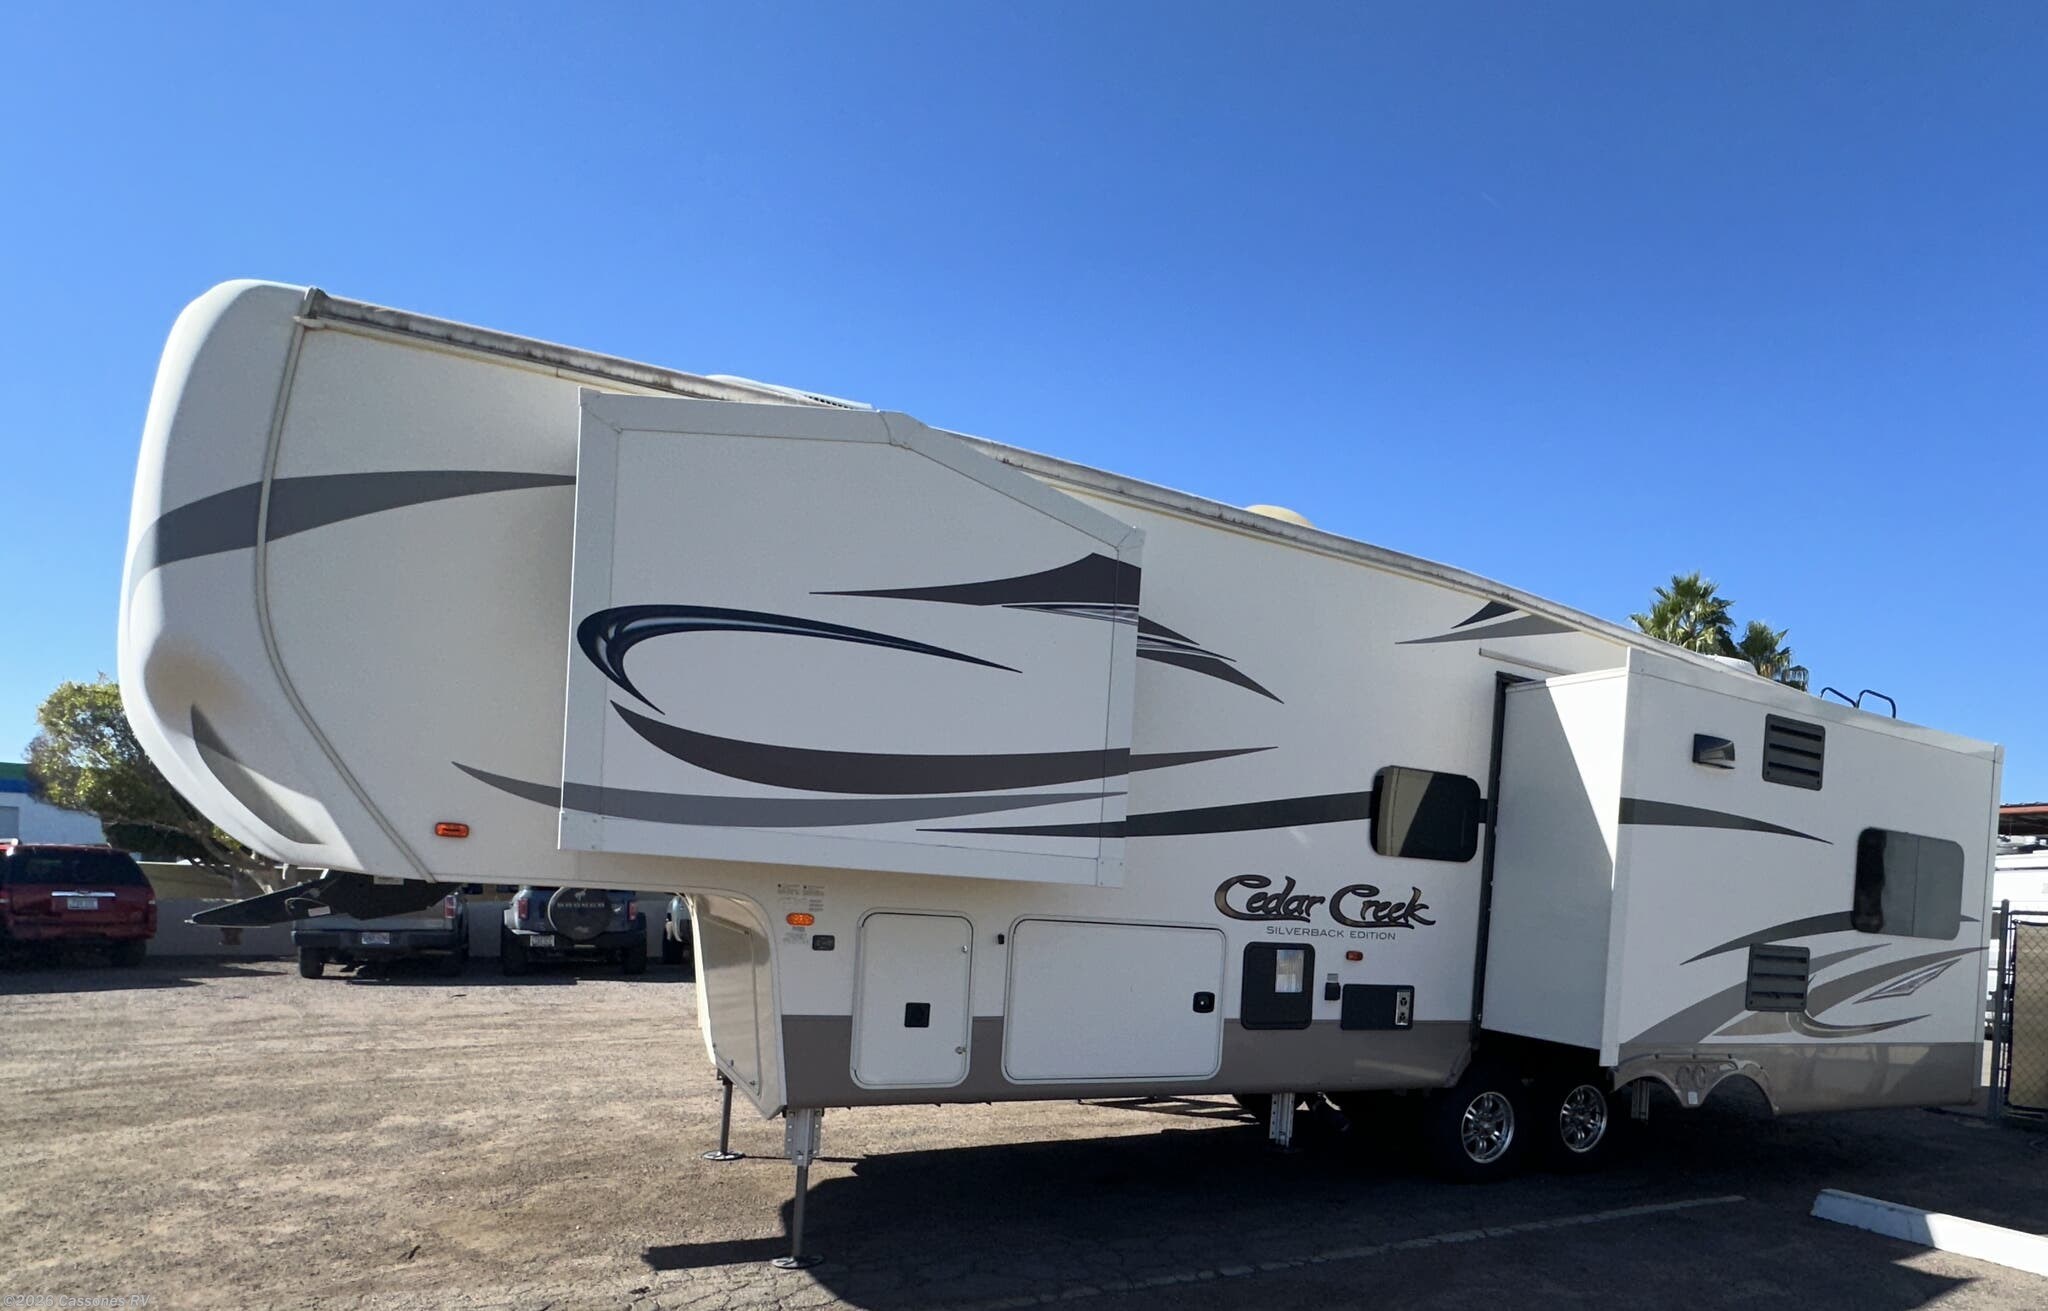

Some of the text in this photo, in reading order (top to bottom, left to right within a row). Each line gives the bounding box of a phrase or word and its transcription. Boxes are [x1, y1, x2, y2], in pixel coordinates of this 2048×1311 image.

[1214, 874, 1436, 930] Cedar Creek
[1266, 926, 1396, 940] SILVERBACK EDITION
